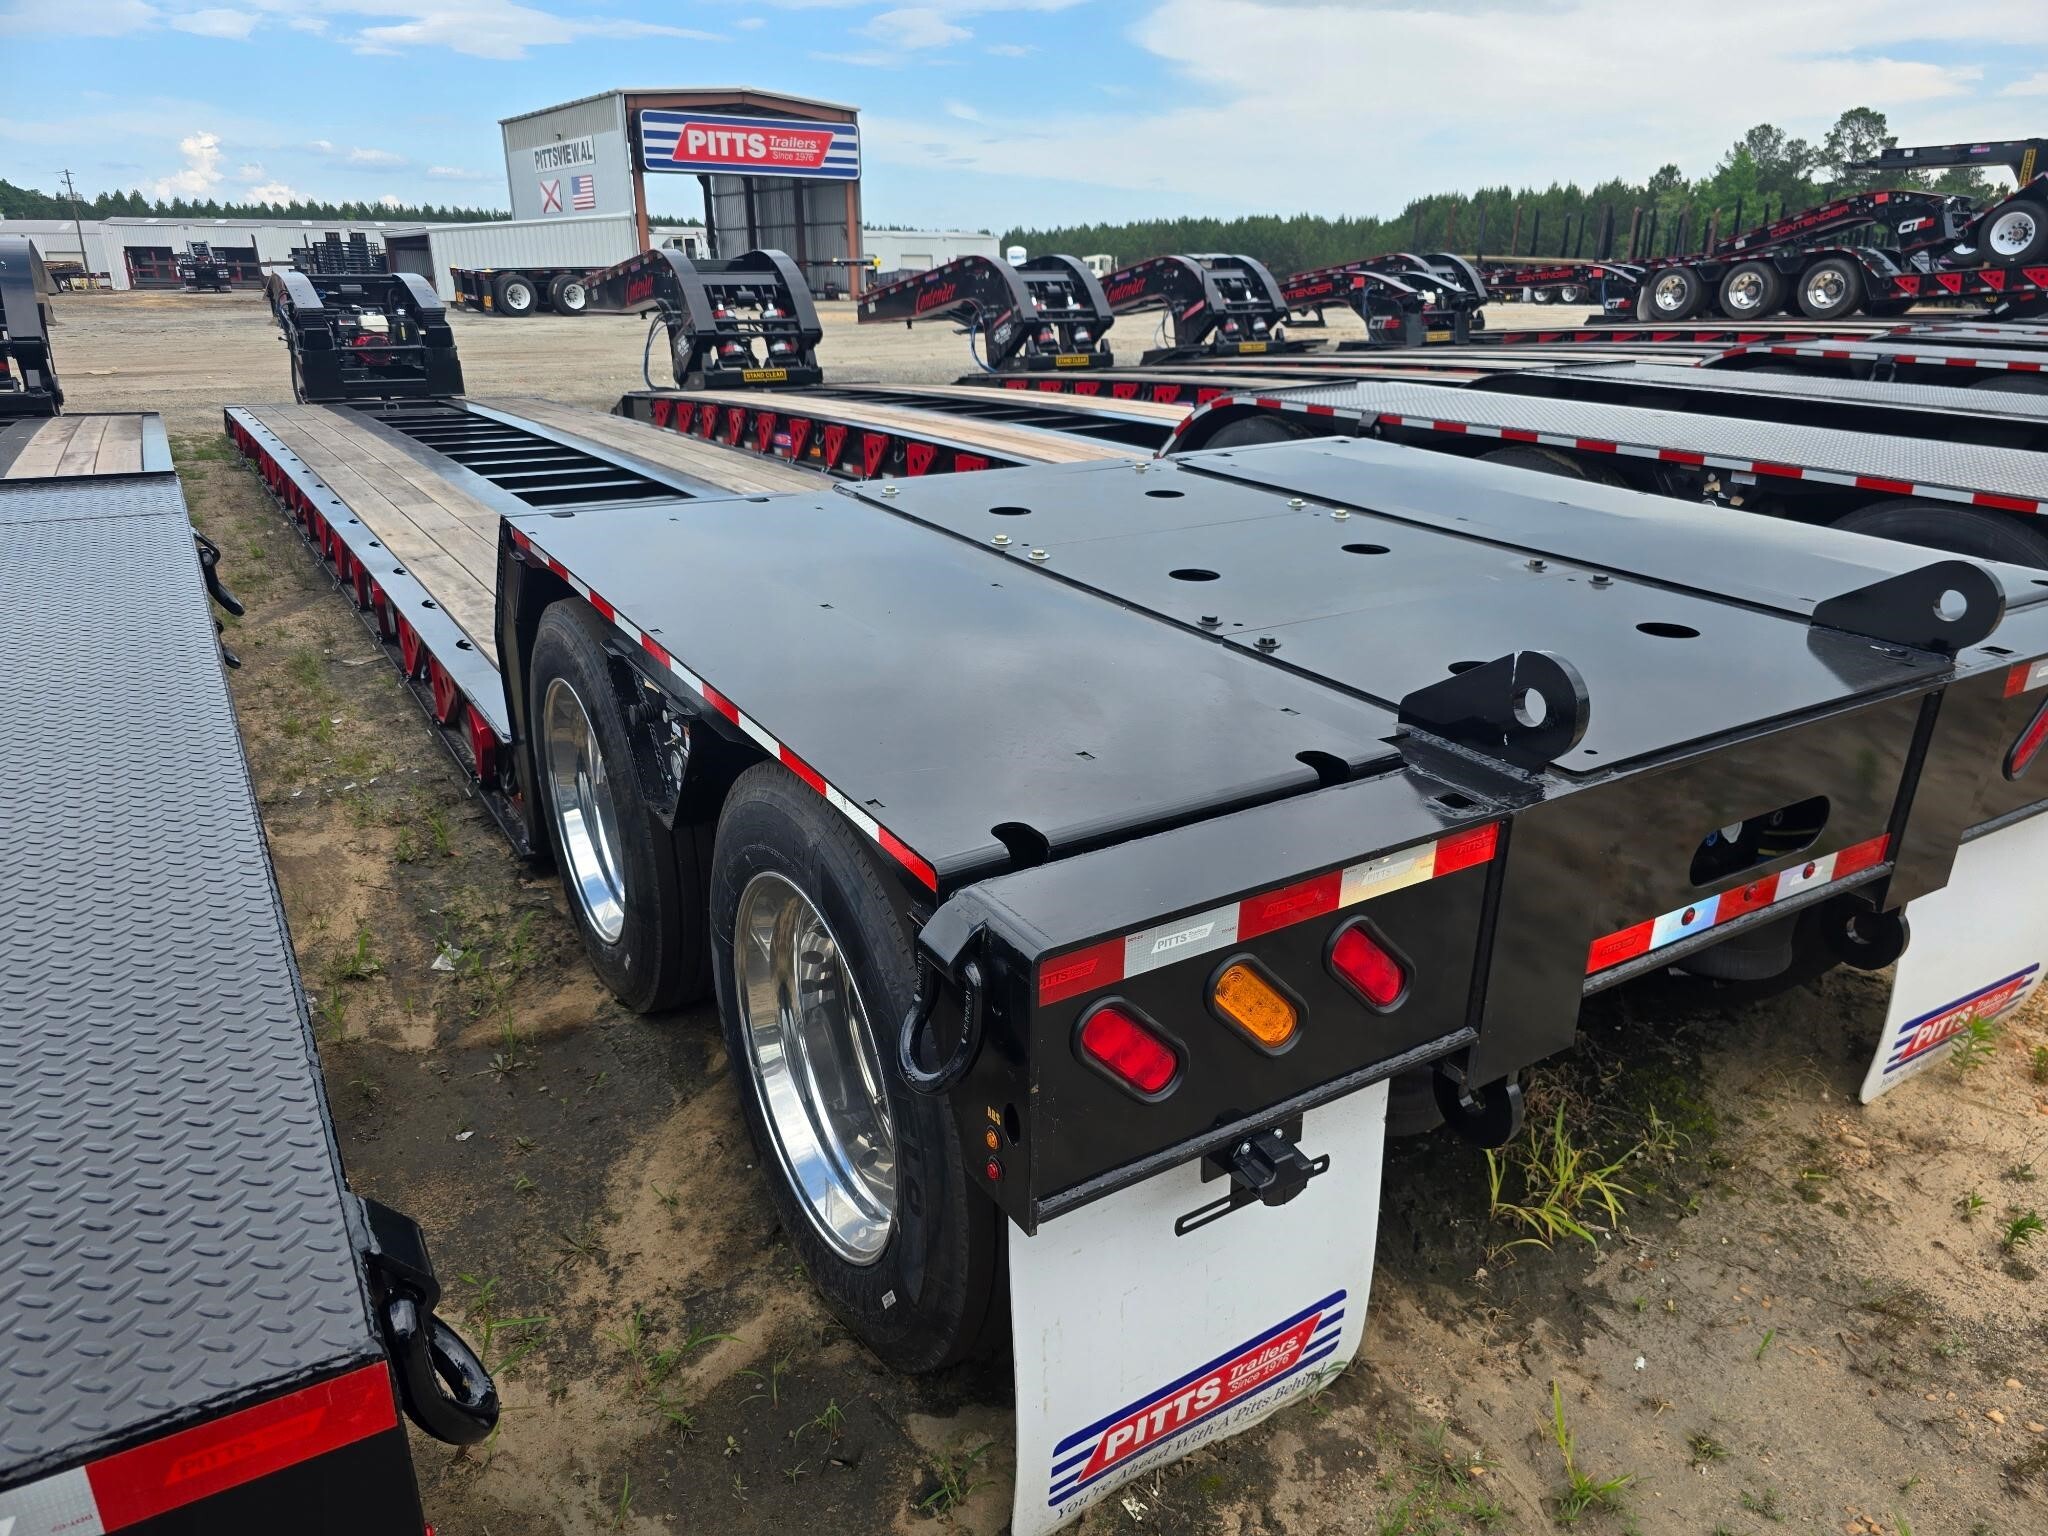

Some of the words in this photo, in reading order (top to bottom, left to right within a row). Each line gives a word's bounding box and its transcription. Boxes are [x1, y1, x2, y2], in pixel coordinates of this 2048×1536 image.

[534, 142, 580, 170] PITTSVIEW
[581, 140, 593, 162] AL
[687, 129, 767, 159] PITTS
[769, 135, 817, 149] Trailers
[772, 150, 794, 161] Since
[795, 151, 815, 162] 1976
[1769, 205, 1850, 238] CONTENDER
[1282, 282, 1333, 300] NTENDER
[1515, 269, 1574, 283] CONTENDER
[915, 282, 957, 316] Contender
[1157, 934, 1188, 950] PITTS
[987, 1105, 1001, 1126] ABS
[1229, 1372, 1260, 1393] Since
[1262, 1354, 1290, 1376] 1976
[1104, 1377, 1222, 1461] PITTS
[1230, 1336, 1298, 1380] Trailers
[1058, 1480, 1112, 1519] You're
[1119, 1444, 1171, 1480] Ahead
[1176, 1423, 1214, 1449] With
[1217, 1414, 1230, 1430] A
